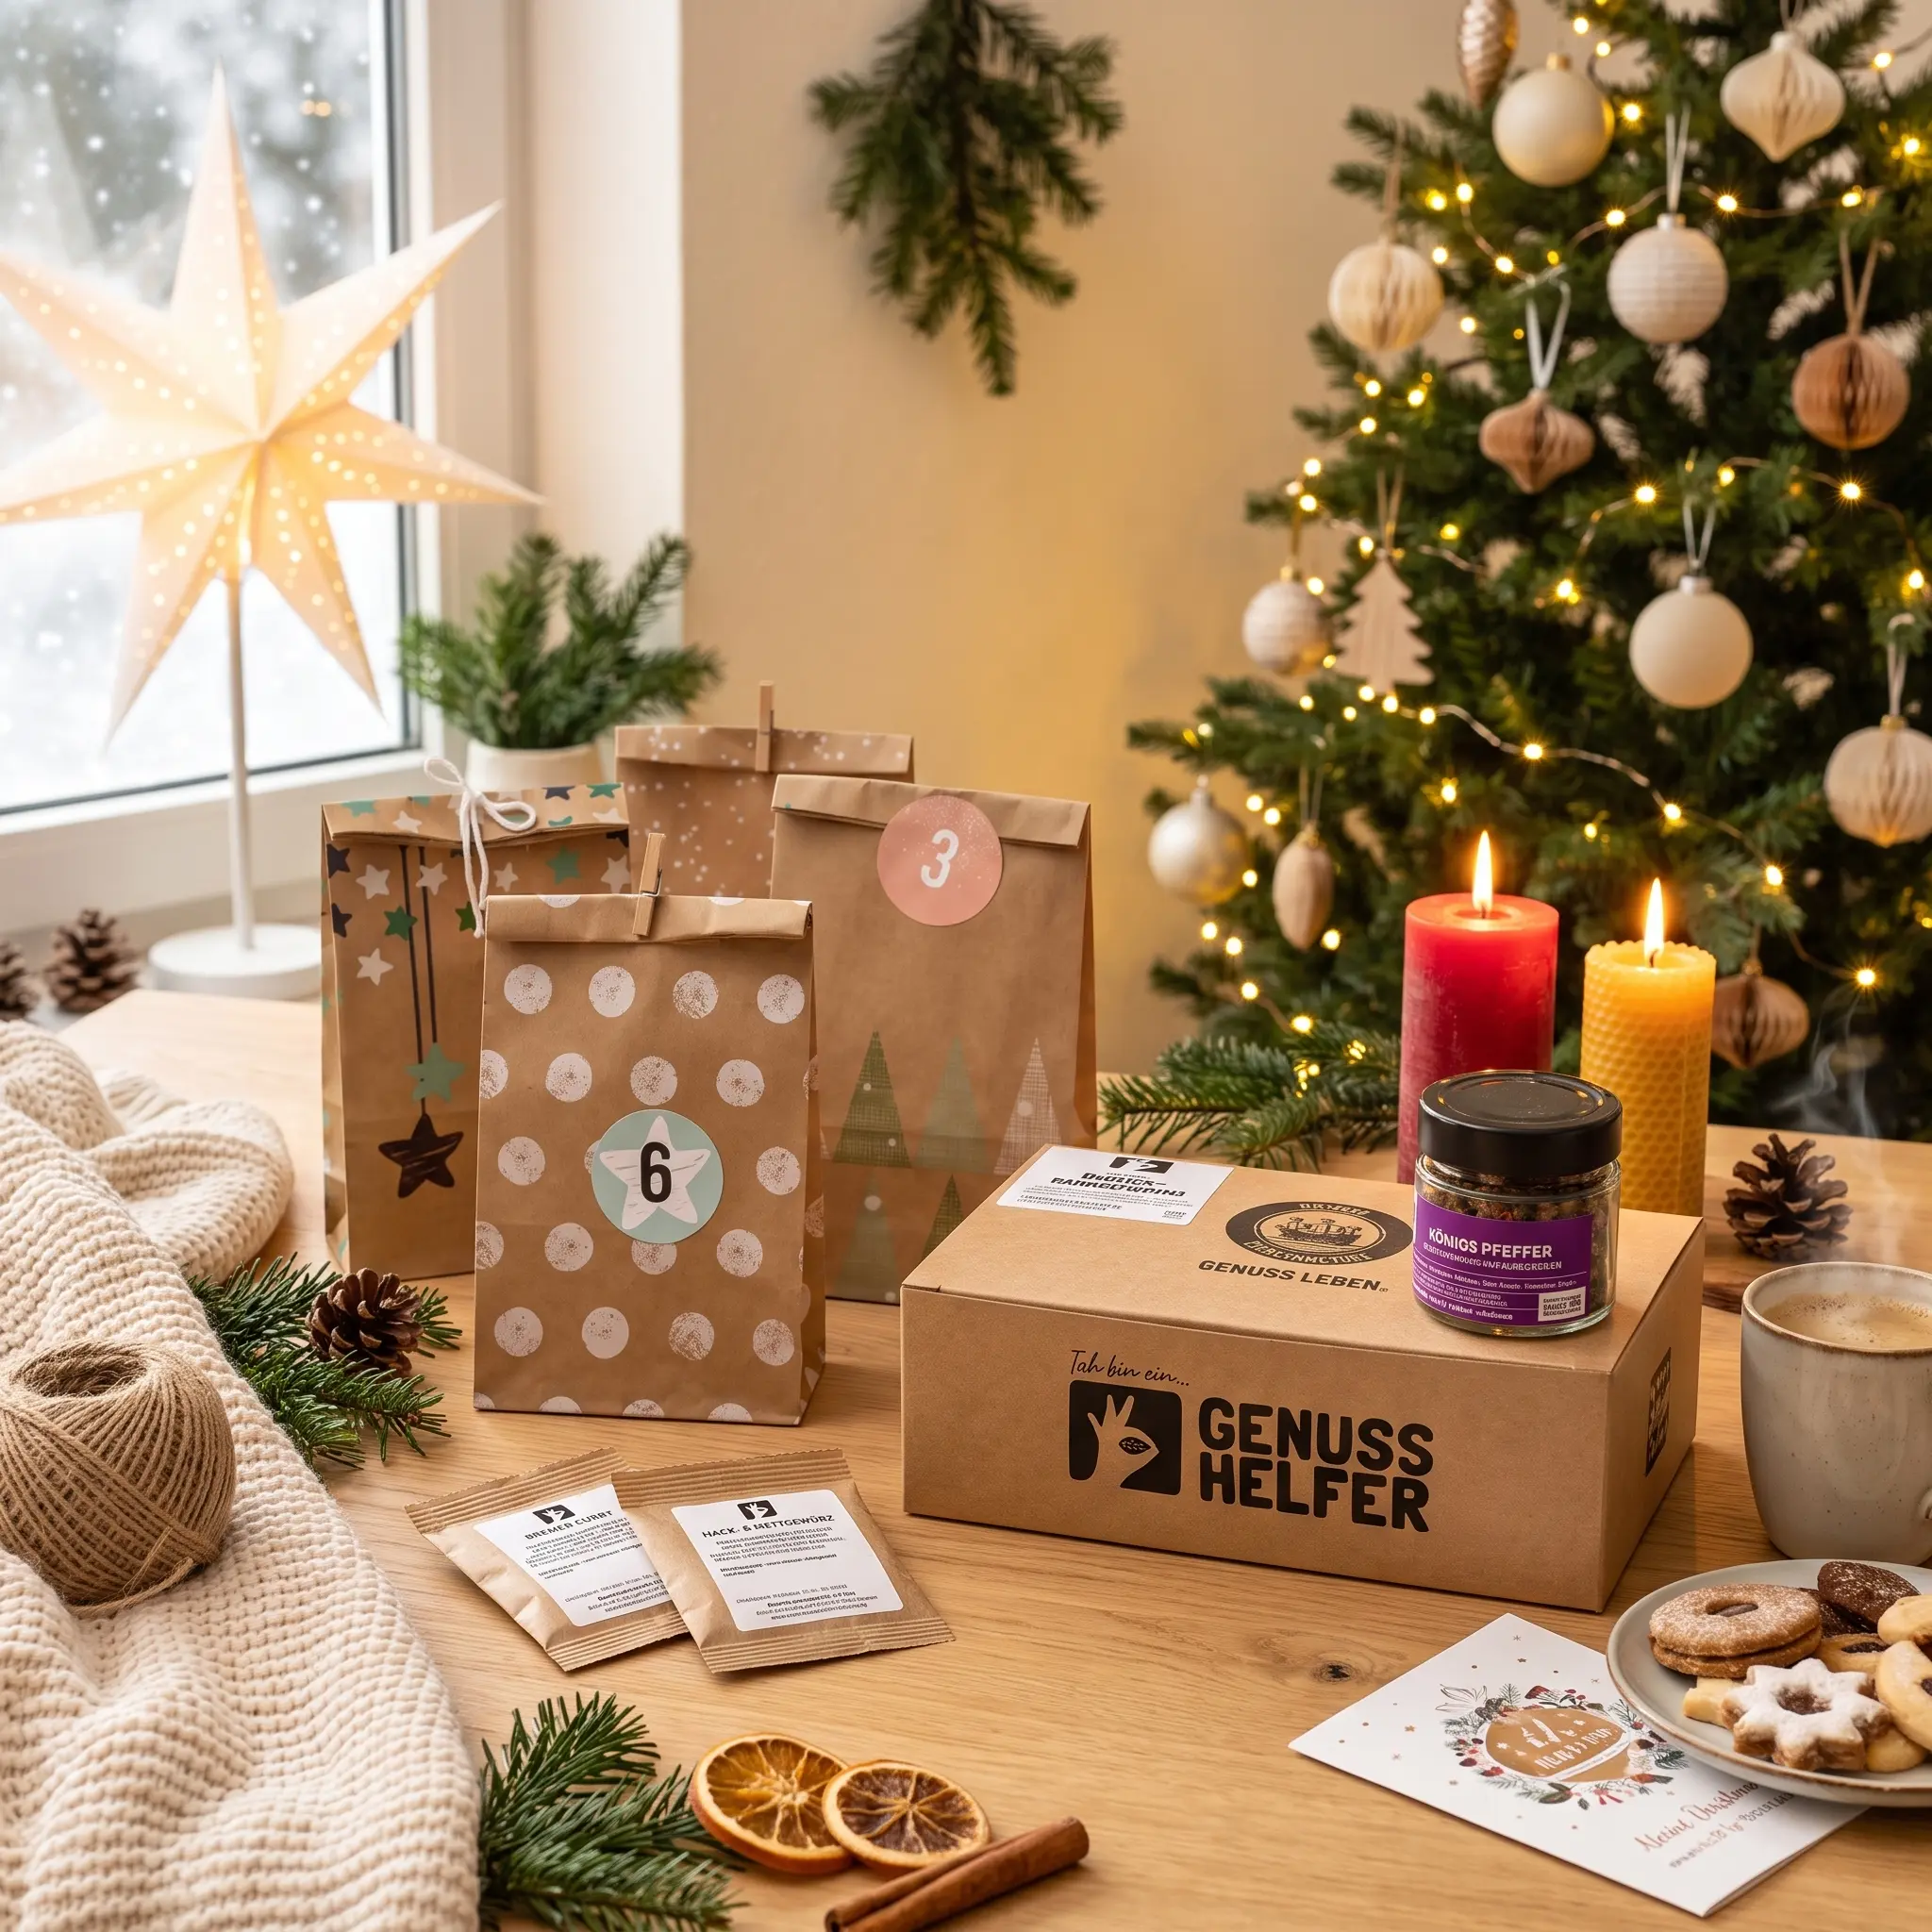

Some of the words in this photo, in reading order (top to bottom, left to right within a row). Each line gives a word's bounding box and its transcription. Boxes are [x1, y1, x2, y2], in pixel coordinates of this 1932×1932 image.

[921, 829, 959, 889] 3
[641, 1141, 672, 1203] 6
[1198, 1259, 1296, 1280] GENUSS
[1300, 1272, 1381, 1291] LEBEN
[1481, 1241, 1553, 1258] PFEFFER
[1107, 1354, 1141, 1377] bin
[1144, 1367, 1190, 1387] ein...
[1198, 1397, 1434, 1476] GENUSS
[1199, 1452, 1430, 1532] HELFER
